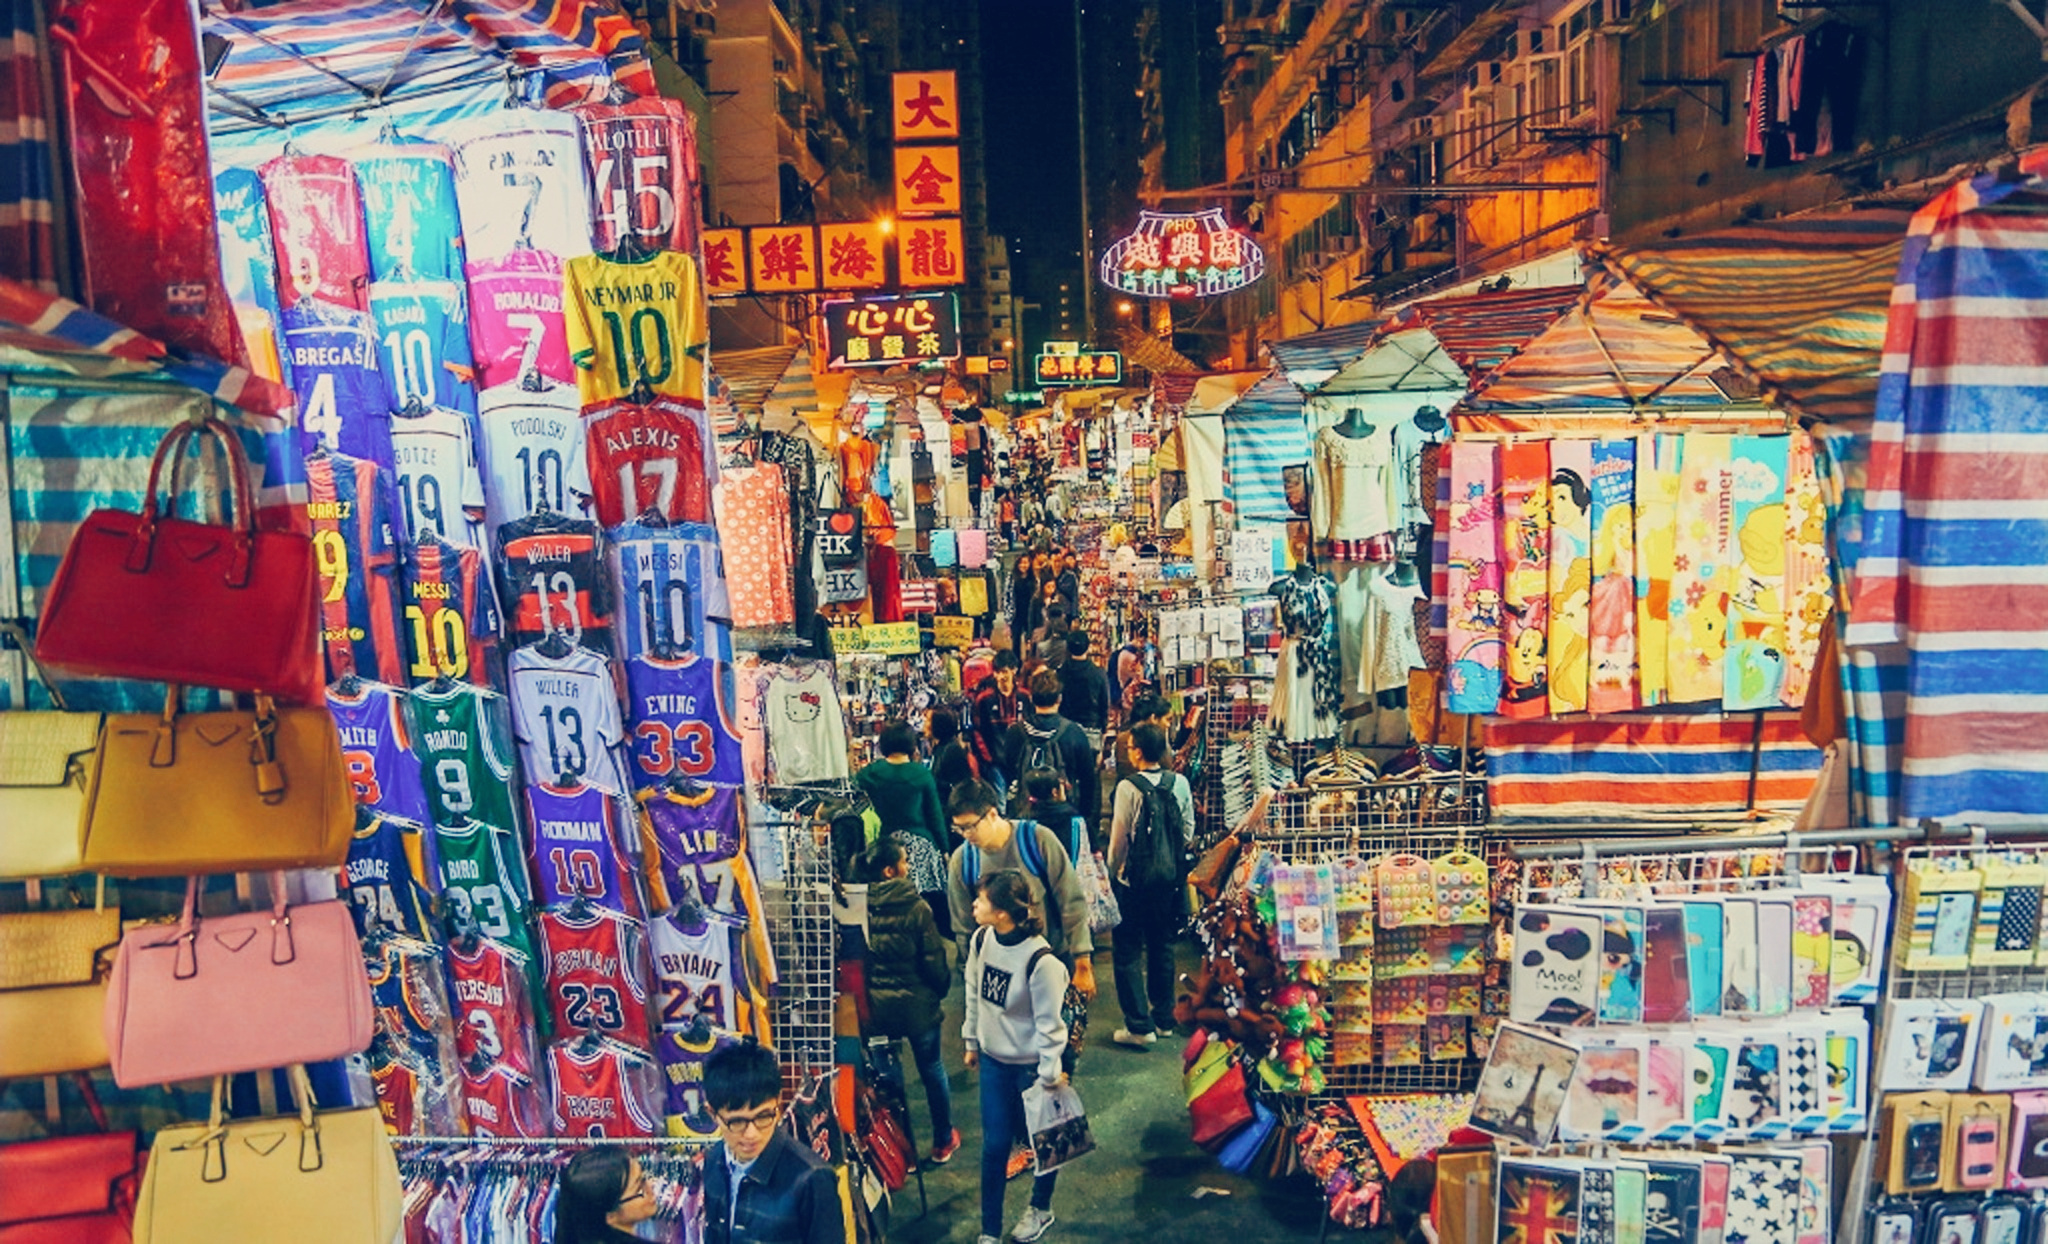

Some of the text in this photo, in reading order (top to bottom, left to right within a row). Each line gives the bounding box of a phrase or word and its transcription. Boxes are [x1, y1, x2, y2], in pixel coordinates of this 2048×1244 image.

[595, 154, 675, 238] 45
[901, 79, 956, 277] 大金龍
[1165, 218, 1197, 231] PHO
[585, 281, 677, 307] NEYMAR JR
[847, 299, 935, 335] 心心
[383, 328, 436, 410] 10
[507, 312, 546, 386] 7
[602, 307, 673, 389] 10
[303, 373, 343, 449] 4
[511, 417, 568, 440] PODOLSKI
[606, 427, 681, 455] ALEXIS
[516, 446, 563, 512] 10
[618, 456, 679, 522] 17
[397, 474, 444, 544] 19
[816, 517, 828, 534] I
[1717, 468, 1733, 554] summer
[313, 529, 348, 603] 9
[639, 553, 683, 571] MESSI
[816, 536, 852, 555] HK
[413, 581, 450, 600] MESSI
[531, 571, 582, 646] 13
[637, 579, 692, 651] 10
[405, 604, 469, 679] 10
[645, 694, 697, 716] EWING
[423, 729, 468, 752] RONDO
[538, 704, 587, 777] 13
[635, 719, 715, 777] 33
[435, 758, 474, 813] 9
[540, 819, 602, 842] RODMAN
[679, 829, 718, 856] LIN
[347, 858, 390, 883] GEORGE
[447, 859, 480, 880] BIRD
[548, 847, 607, 898] 10
[677, 857, 738, 915] 17
[352, 884, 407, 934] 24
[449, 883, 511, 937] 33
[660, 952, 723, 981] BRYANT
[1536, 968, 1582, 983] Moo!
[559, 982, 625, 1030] 23
[660, 977, 726, 1030] 24
[468, 1008, 503, 1057] 3
